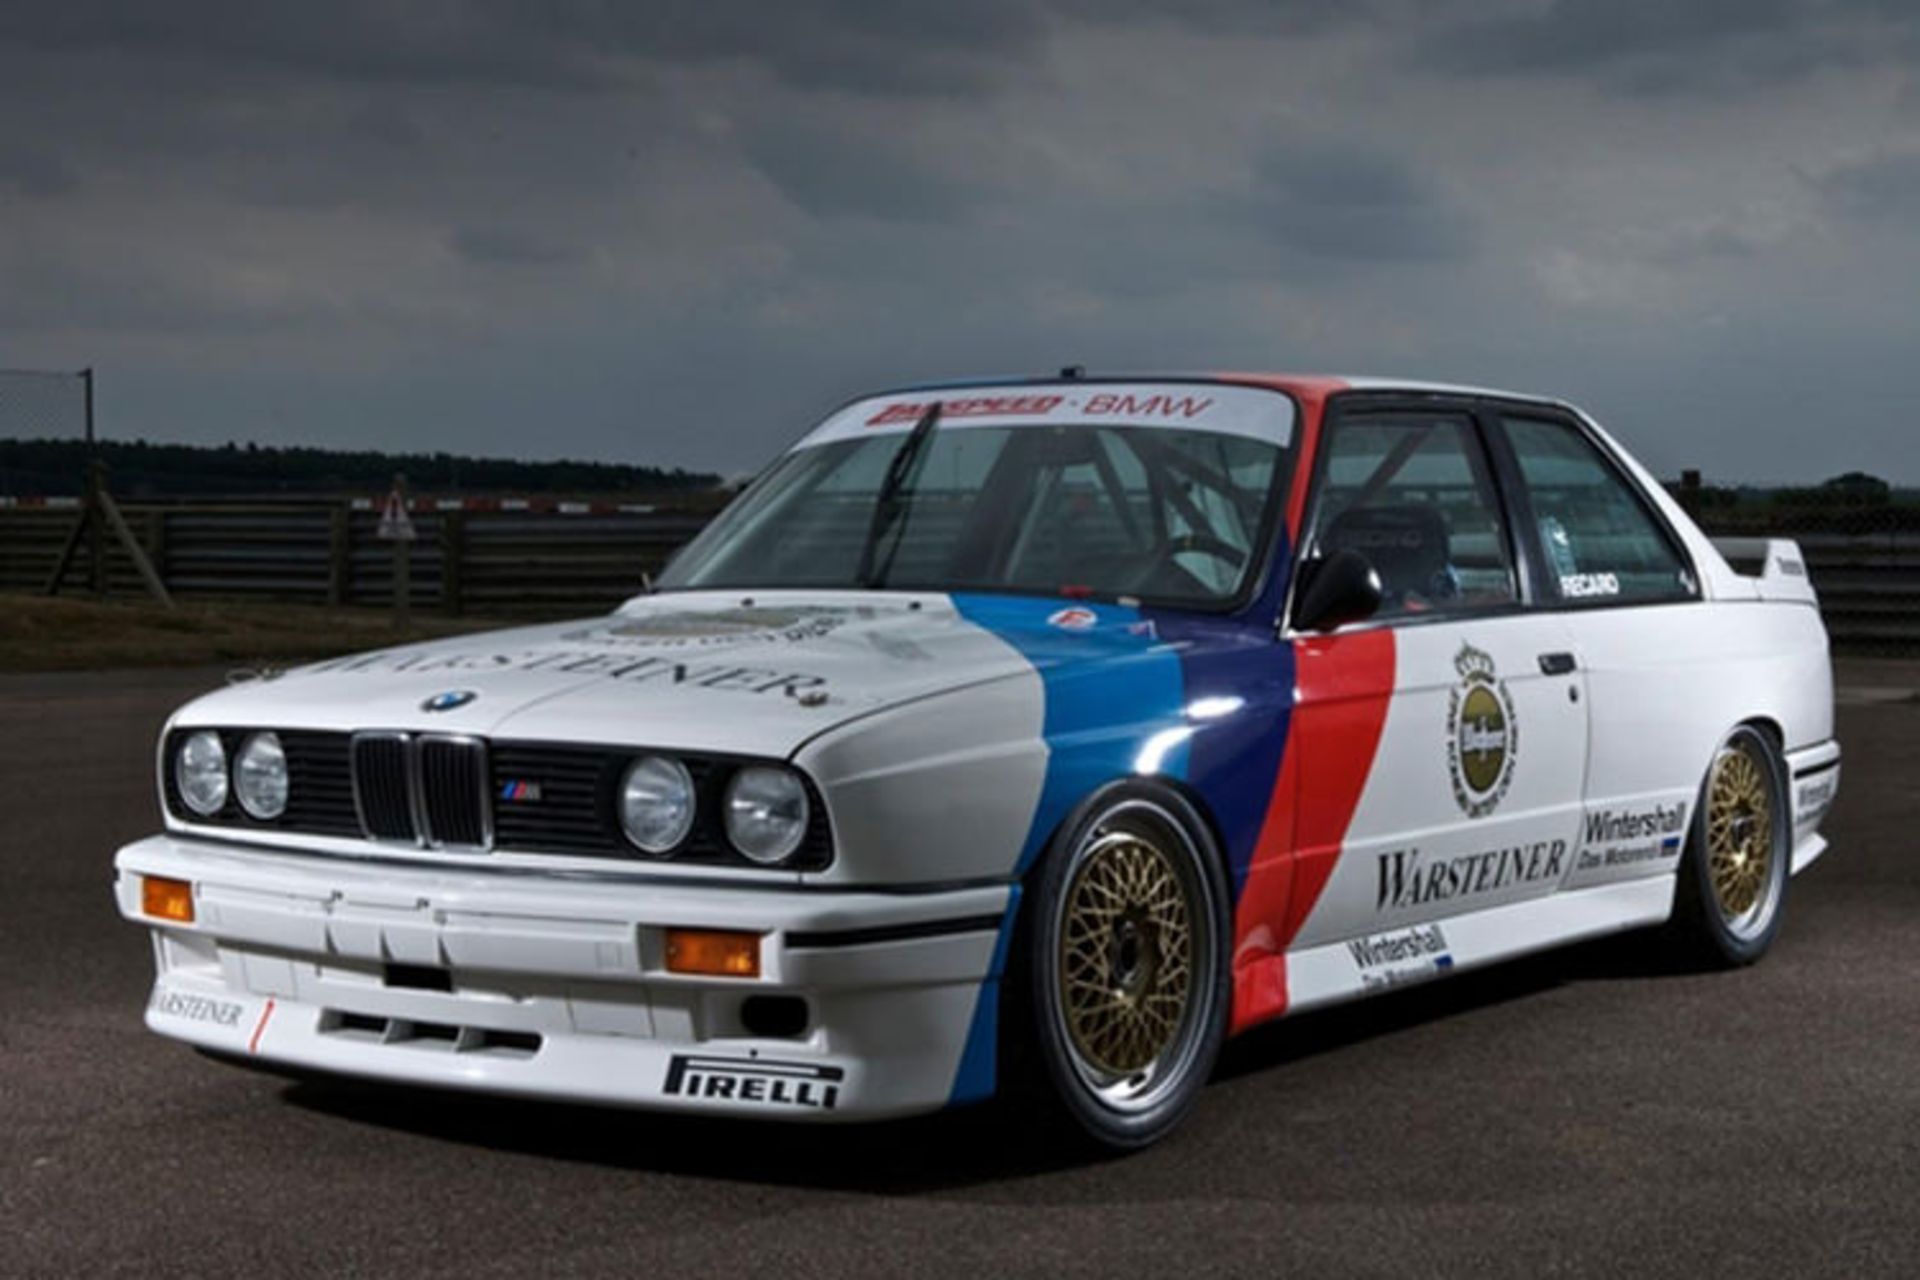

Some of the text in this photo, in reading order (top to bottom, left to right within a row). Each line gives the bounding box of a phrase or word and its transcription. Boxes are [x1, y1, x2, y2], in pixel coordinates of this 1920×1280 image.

[1084, 394, 1214, 418] BMW
[1560, 572, 1620, 597] RECARO
[1585, 802, 1686, 843] Wintershall
[1376, 839, 1566, 910] WARSTEINER
[1347, 923, 1447, 968] Wintershall
[663, 1054, 844, 1109] PIRELLI
